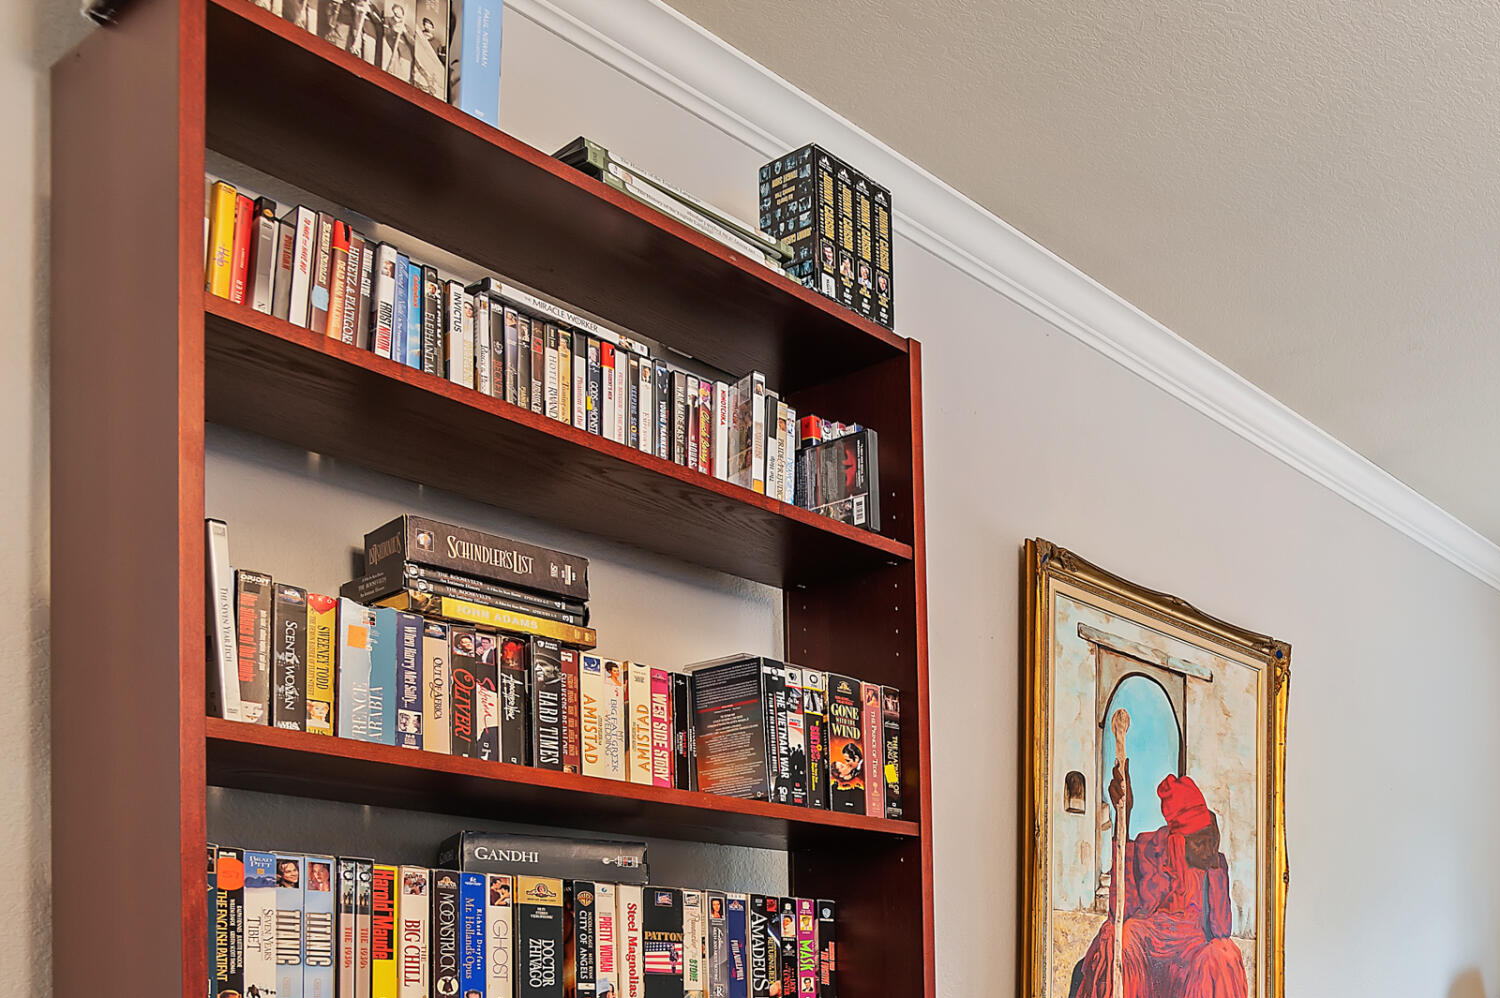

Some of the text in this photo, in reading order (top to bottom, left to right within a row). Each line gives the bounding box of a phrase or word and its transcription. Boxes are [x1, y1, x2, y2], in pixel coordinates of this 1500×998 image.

[823, 171, 835, 240] JOHNNY CARSON
[842, 184, 854, 252] JOHNNY CARSON
[861, 195, 872, 262] JOHNNY CARSON
[879, 207, 890, 272] JOHNNY CARSON
[377, 301, 392, 352] FROST NIXON
[425, 311, 435, 361] ELEPHANT
[453, 291, 462, 333] INVICTUS
[532, 299, 599, 333] MIRACLE WORKER
[493, 360, 502, 395] BECKET
[512, 551, 534, 575] LIST
[457, 606, 539, 630] JOHN ADAMS
[317, 625, 330, 690] SWEENEY TODD
[430, 657, 443, 720] OUT OF AFRICA
[453, 668, 475, 742] OLIVER!
[831, 702, 859, 721] GONE
[539, 690, 559, 764] HARD TIMES
[583, 694, 598, 764] AMISTAD
[636, 704, 650, 773] AMISTAD
[653, 693, 669, 781] WEST SIDE STORY
[776, 691, 790, 779] THE VIETNAM WAR
[831, 723, 861, 740] WIND
[474, 847, 539, 863] GANDHI
[247, 916, 262, 953] TIBET
[262, 908, 274, 961] SEVEN YEARS
[276, 909, 301, 966] TITANIC
[305, 912, 333, 968] TITANIC
[373, 870, 394, 960] Harold Maude
[439, 892, 455, 973] MOONSTRUCK
[645, 930, 684, 942] PATTON
[404, 919, 420, 987] BIG CHILL
[492, 919, 508, 982] GHOST
[529, 938, 542, 988] ZHIVAGO
[542, 940, 555, 988] DOCTOR
[580, 948, 588, 980] ANGELS
[599, 916, 613, 973] PRETTY WOMAN
[626, 903, 639, 998] Steel Magnolias
[751, 910, 770, 991] AMADEUS
[800, 940, 814, 972] MASK
